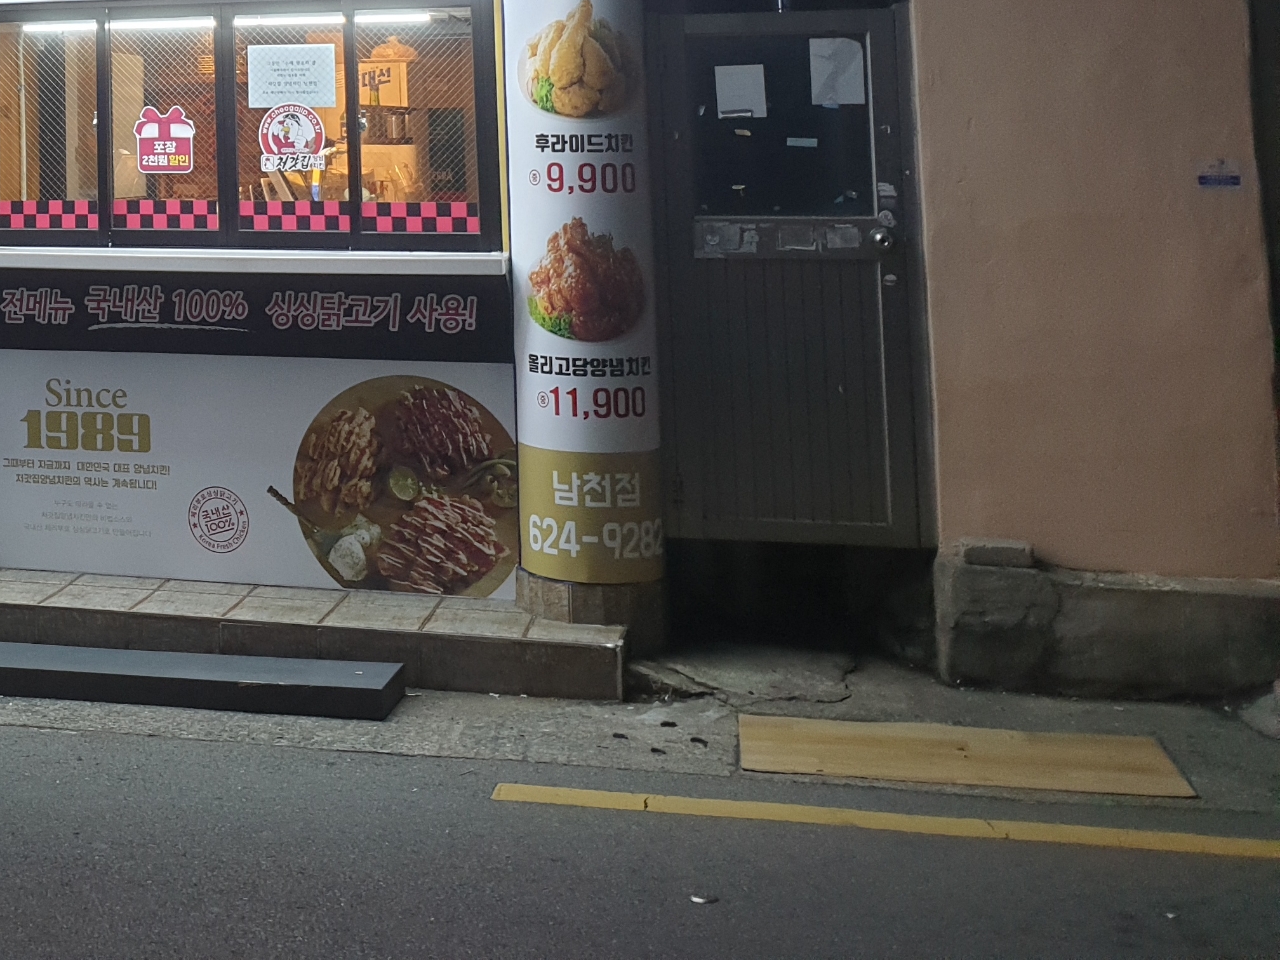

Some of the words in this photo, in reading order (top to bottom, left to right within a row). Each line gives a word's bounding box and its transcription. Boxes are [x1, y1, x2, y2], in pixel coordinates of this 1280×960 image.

[263, 105, 321, 134] www.cheogajip.co.kr
[154, 141, 176, 153] 포장
[535, 133, 633, 152] 후라이드치킨
[142, 155, 168, 166] 2천원
[169, 155, 188, 166] 할인
[276, 154, 311, 169] 처갓집
[547, 162, 635, 195] 9,900
[0, 288, 75, 324] 전메뉴
[84, 285, 164, 322] 국내산
[172, 289, 248, 322] 100%
[265, 291, 401, 332] 싱싱닭고기
[406, 293, 477, 334] 사용!
[528, 353, 651, 378] 올리고당양념치킨
[45, 378, 127, 409] Since
[549, 386, 645, 420] 11,900
[20, 409, 151, 453] 1989
[3, 458, 35, 469] 그때부터
[76, 461, 110, 472] 대한민국
[114, 462, 130, 473] 대표
[133, 464, 170, 475] 양념치킨!
[16, 474, 81, 486] 처갓집양념치킨의
[84, 478, 108, 487] 역사는
[112, 478, 157, 490] 계속됩니다!
[552, 471, 640, 507] 남천점
[202, 504, 231, 519] 국내산
[199, 534, 216, 548] Korea
[216, 541, 233, 550] Fresh
[232, 521, 247, 545] Chicken
[205, 518, 235, 533] 100%
[529, 514, 663, 559] 624-9282
